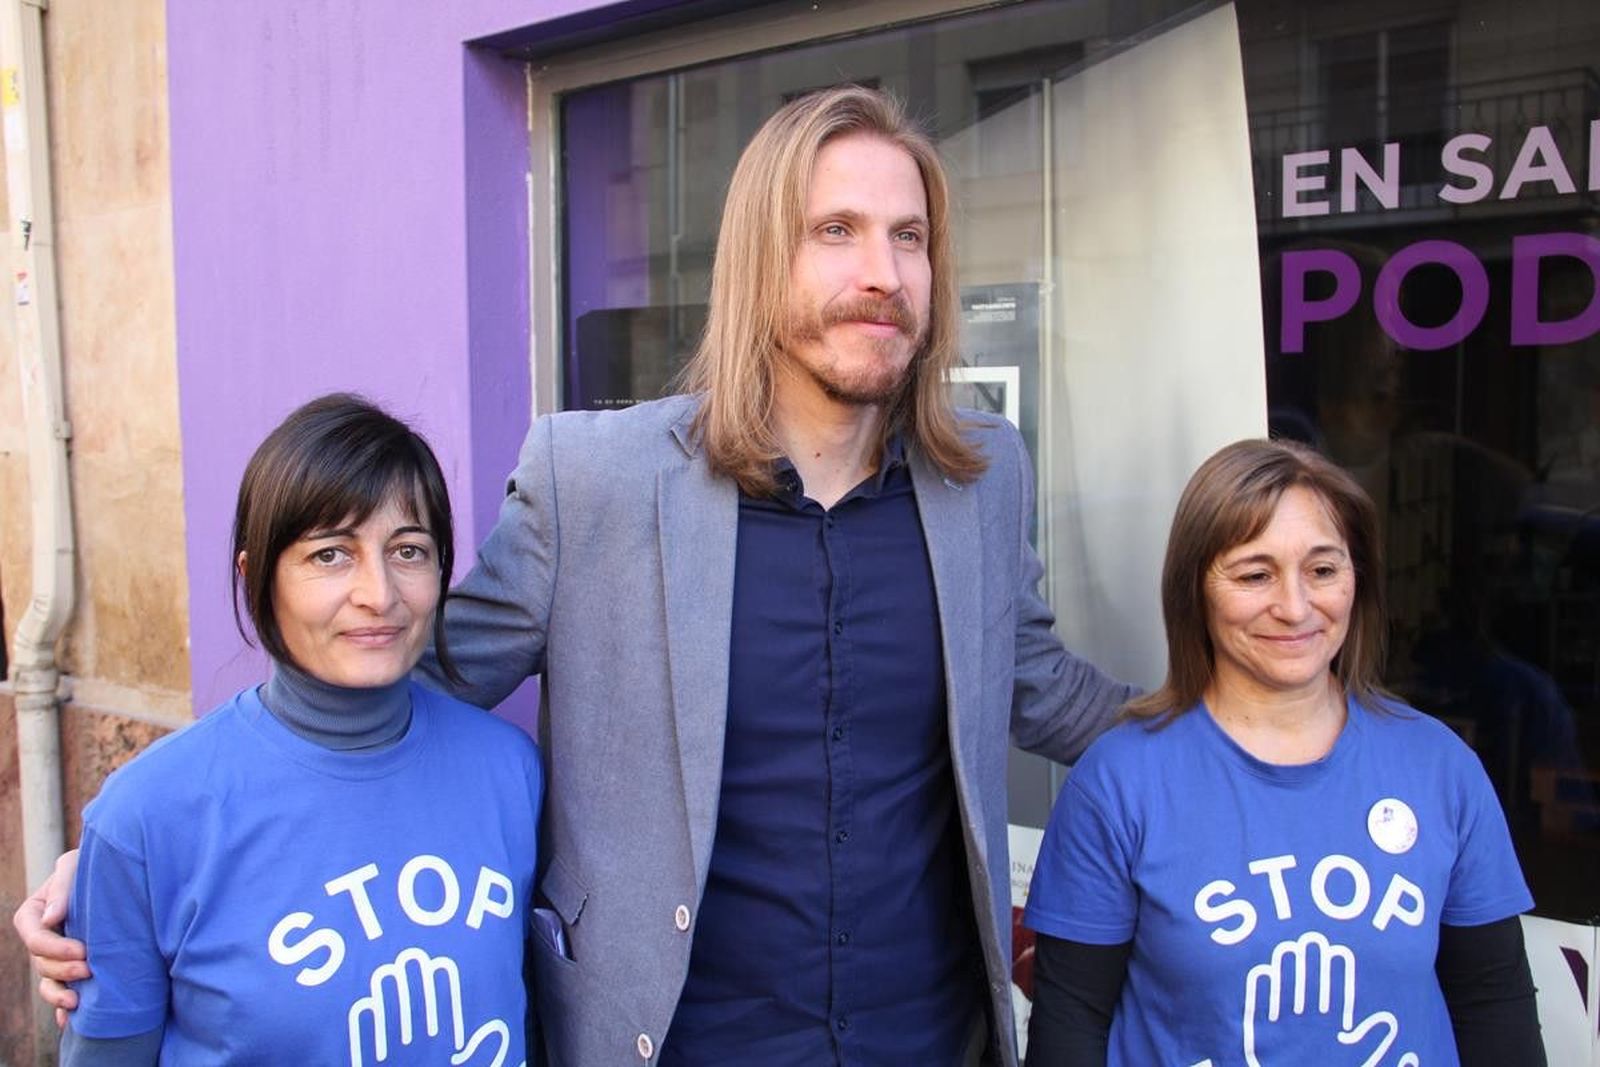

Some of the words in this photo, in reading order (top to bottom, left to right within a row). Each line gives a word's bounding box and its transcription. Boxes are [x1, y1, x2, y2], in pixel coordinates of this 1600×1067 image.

[1282, 142, 1400, 217] EN
[268, 854, 515, 986] STOP
[1194, 854, 1425, 945] STOP
